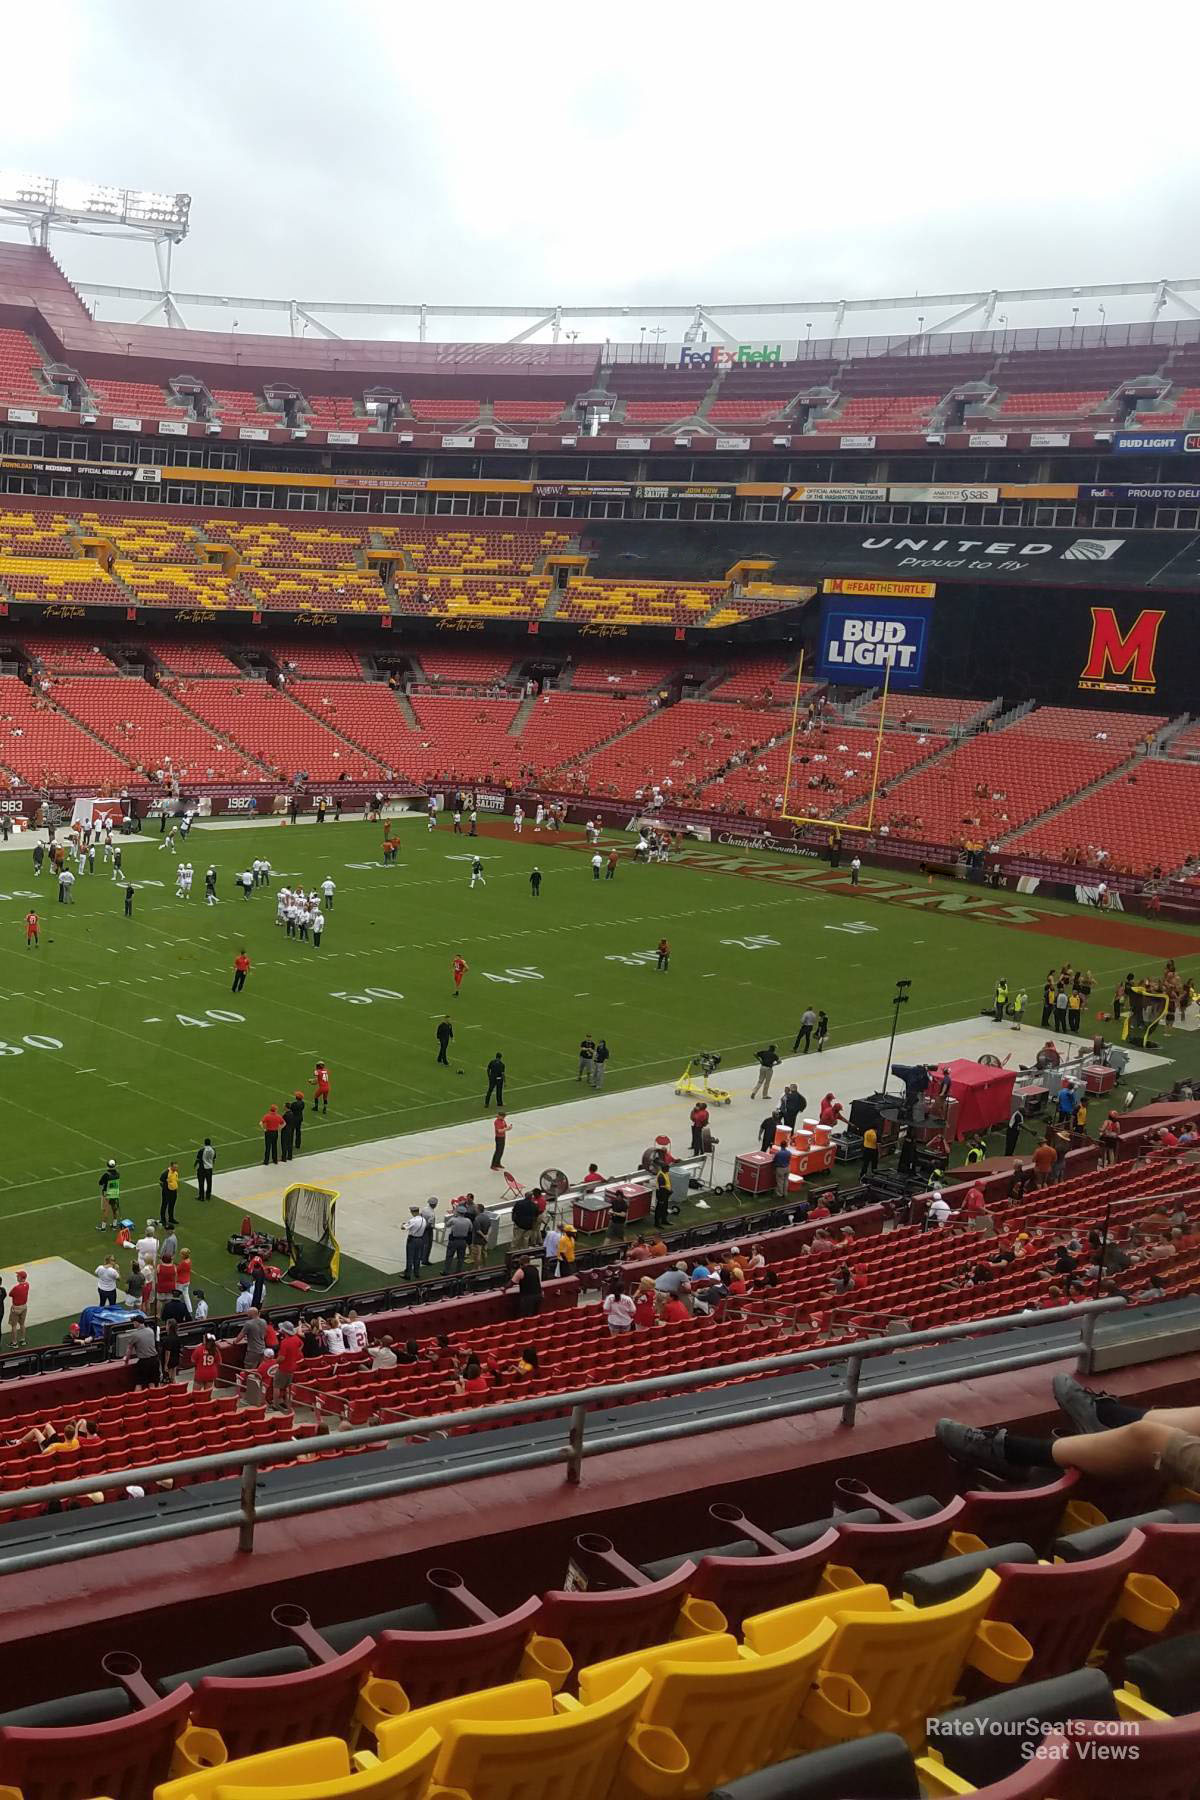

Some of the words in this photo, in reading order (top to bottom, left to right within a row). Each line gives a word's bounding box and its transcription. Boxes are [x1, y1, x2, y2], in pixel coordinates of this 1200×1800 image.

[679, 344, 782, 366] FedExField
[1119, 439, 1143, 448] BUD
[1143, 438, 1177, 448] LIGHT
[968, 489, 989, 500] sas
[1090, 488, 1115, 498] FedEx
[1127, 489, 1162, 498] PROUD
[1163, 489, 1176, 498] TO
[1177, 489, 1200, 499] DELI
[861, 537, 1054, 556] UNITED
[897, 556, 961, 569] Proud
[968, 559, 993, 569] to
[996, 558, 1030, 572] fly
[846, 580, 927, 595] #FEARTHETURTLE
[842, 619, 907, 644] BUD
[1080, 607, 1166, 683] M
[828, 640, 917, 669] LIGHT
[227, 797, 252, 809] 1987
[475, 799, 505, 810] SALUTE
[717, 831, 766, 850] Charitable
[765, 838, 819, 857] Foundation
[719, 933, 783, 951] 20
[328, 986, 406, 1006] 50
[174, 1007, 248, 1030] 40
[202, 1354, 215, 1367] 19
